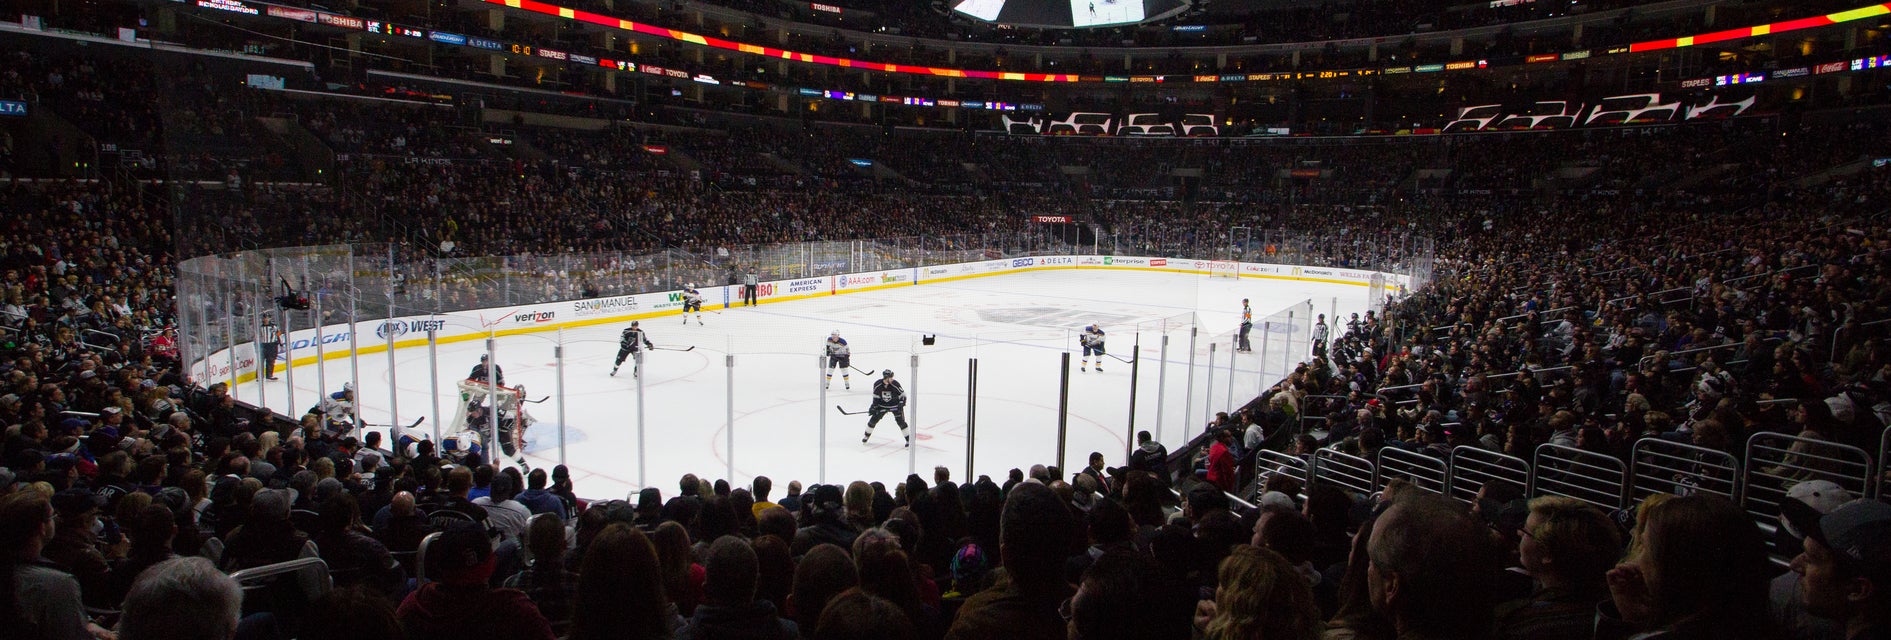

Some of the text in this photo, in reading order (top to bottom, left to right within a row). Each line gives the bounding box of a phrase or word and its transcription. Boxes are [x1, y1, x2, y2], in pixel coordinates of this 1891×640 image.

[812, 3, 841, 13] TOSHIBA
[476, 40, 502, 50] DELTA
[540, 49, 566, 60] STAPLES
[1446, 62, 1475, 70] TOSHIBA
[665, 69, 689, 79] TOYOTA
[1681, 78, 1710, 88] STAPLES
[1012, 258, 1034, 268] GEICO
[790, 279, 822, 287] AMERICAN
[790, 285, 817, 293] EXPRESS
[575, 301, 594, 312] SAN
[601, 296, 638, 309] MANUEL
[515, 310, 555, 323] verizon
[411, 320, 446, 333] WEST
[310, 331, 357, 347] LGHT
